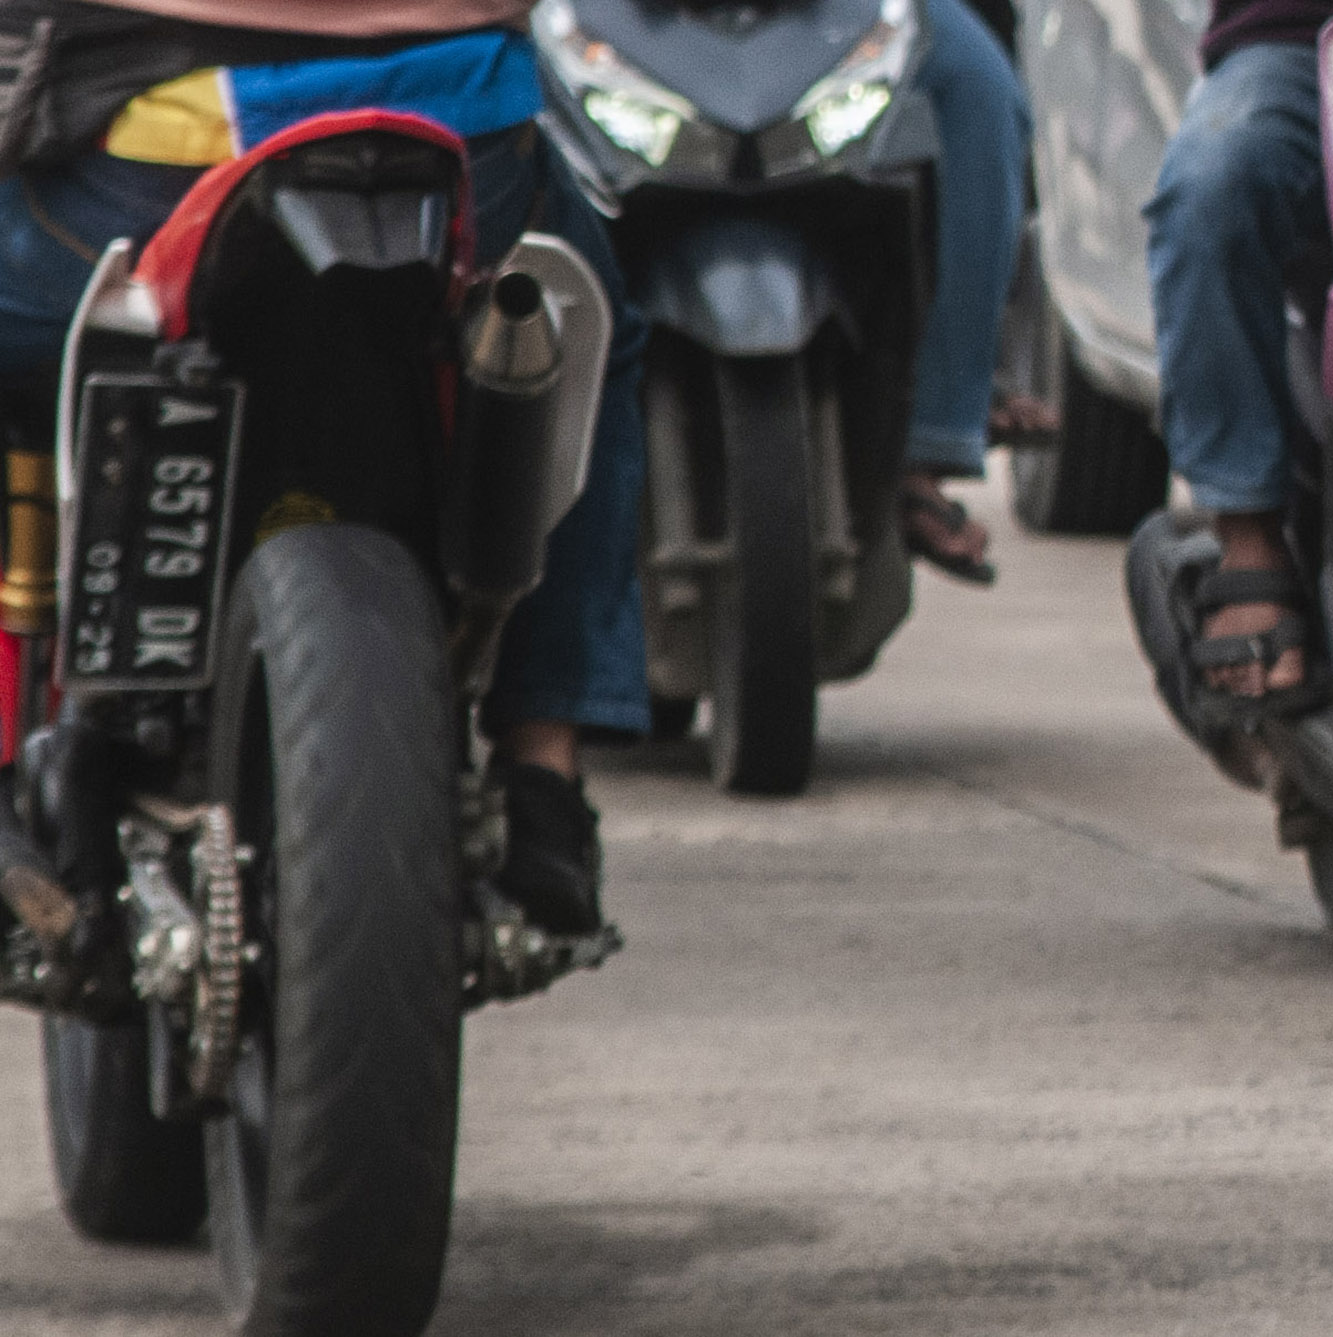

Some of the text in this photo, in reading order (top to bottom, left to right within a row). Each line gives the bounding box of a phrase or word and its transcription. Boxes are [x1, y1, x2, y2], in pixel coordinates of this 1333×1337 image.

[132, 396, 218, 668] A 6579 DK
